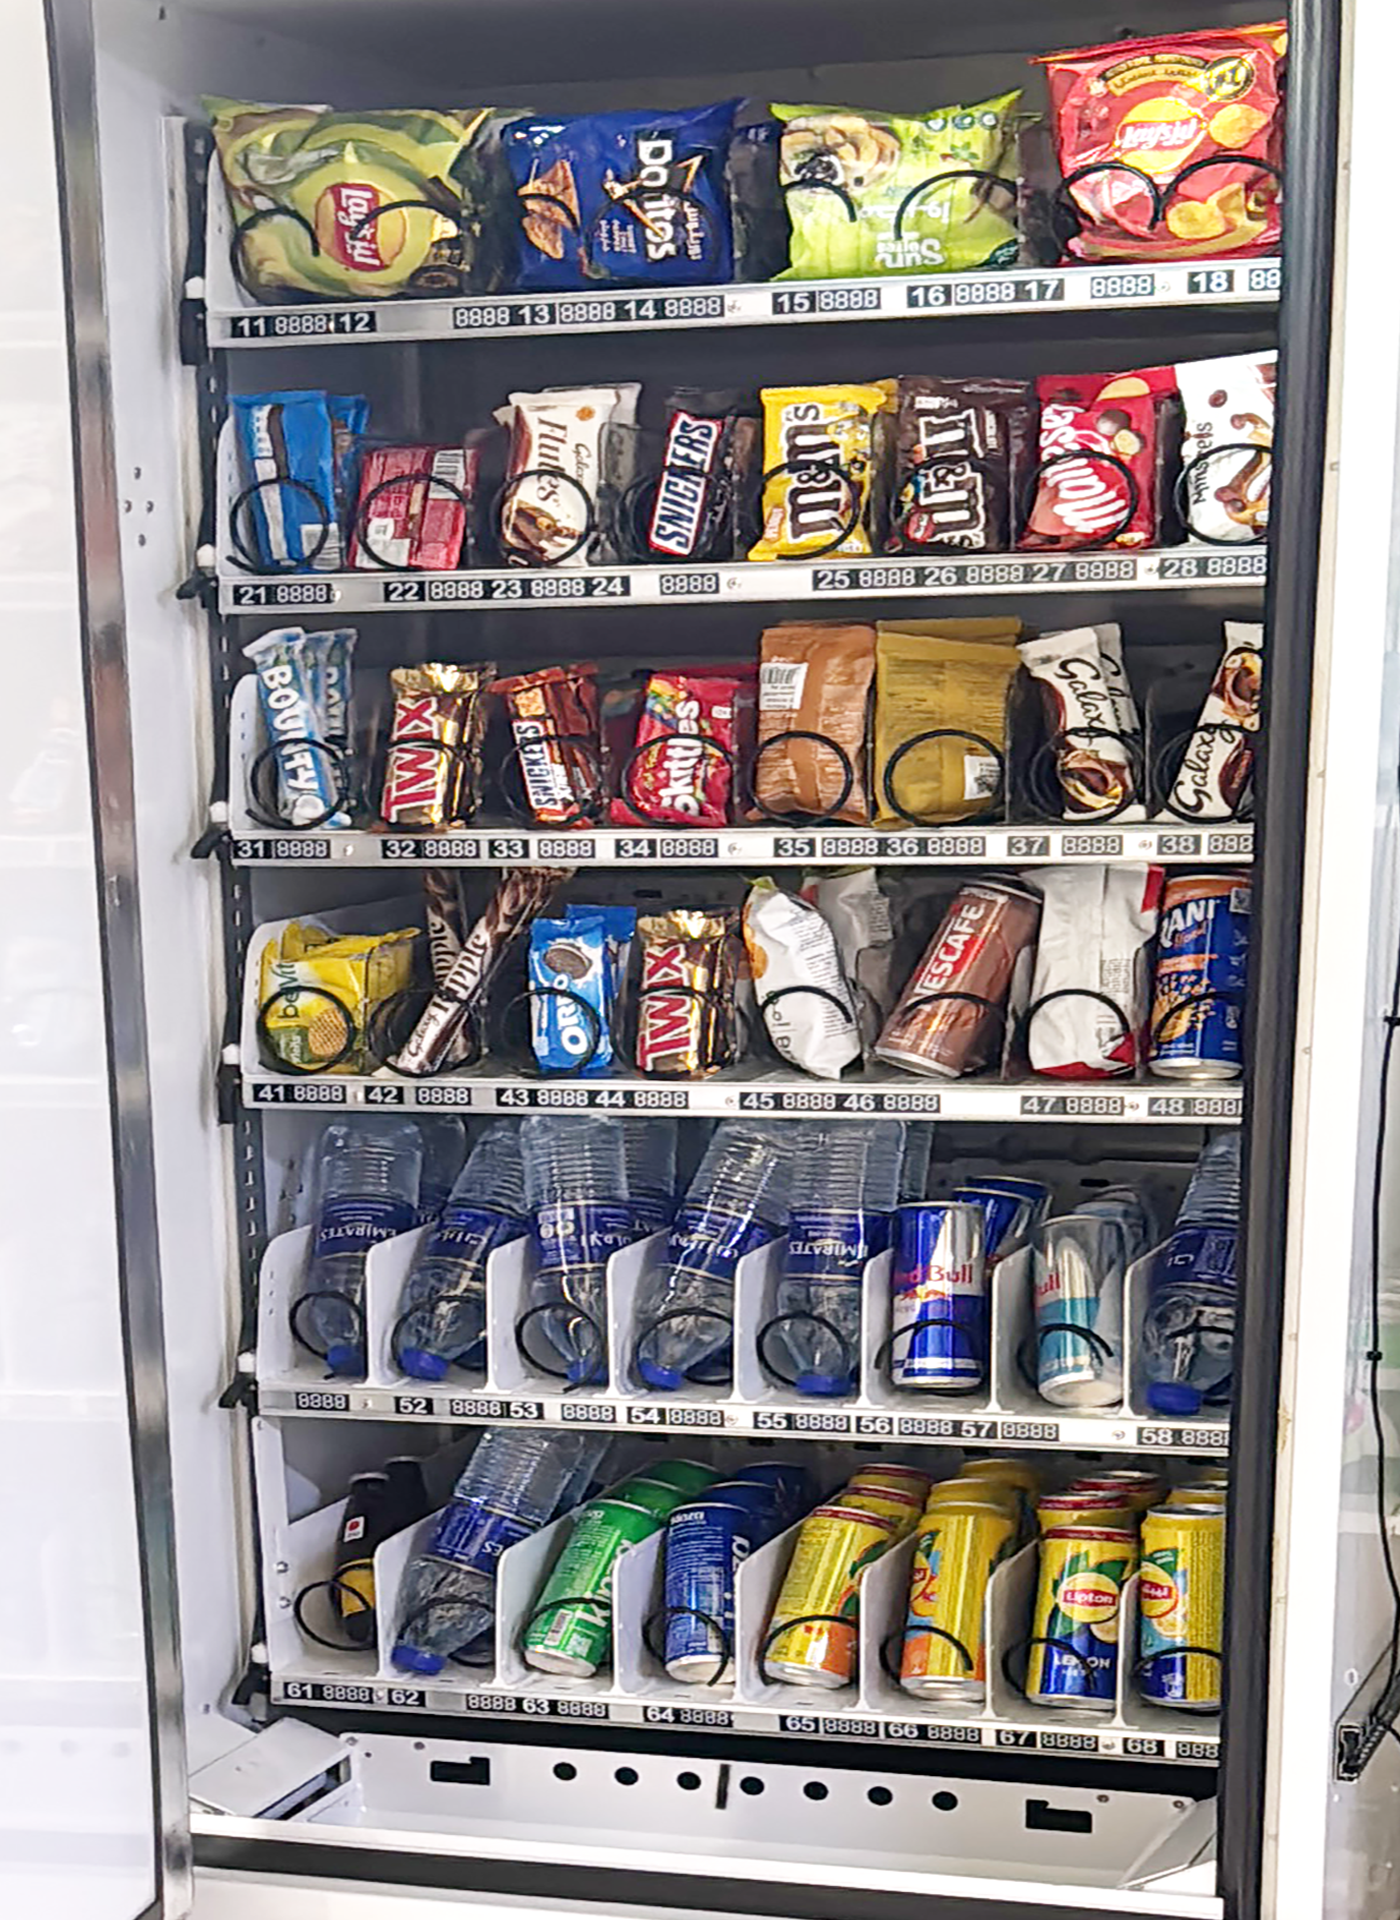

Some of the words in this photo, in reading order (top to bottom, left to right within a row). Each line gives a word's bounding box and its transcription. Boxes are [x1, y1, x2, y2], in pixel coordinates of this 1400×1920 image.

[638, 140, 678, 261] Doitos
[237, 319, 264, 335] 11
[275, 316, 327, 334] 8888
[340, 315, 369, 332] 12
[456, 308, 511, 326] 8888
[520, 306, 549, 324] 13
[561, 303, 615, 320] 8888
[625, 301, 656, 318] 14
[665, 298, 720, 315] 8888
[779, 294, 810, 312] 15
[821, 291, 878, 310] 8888
[913, 288, 944, 305] 16
[956, 285, 1014, 303] 8888
[1025, 282, 1058, 300] 17
[1093, 277, 1152, 295] 8888
[1195, 274, 1228, 291] 18
[572, 443, 592, 486] Galax
[240, 586, 267, 603] 21
[276, 585, 327, 602] 8888
[390, 583, 418, 600] 22
[431, 582, 482, 598] 8888
[493, 580, 522, 597] 23
[531, 579, 584, 596] 8888
[592, 577, 623, 595] 24
[662, 575, 715, 592] 8888
[819, 570, 850, 588] 25
[860, 568, 915, 586] 8888
[924, 567, 958, 585] 26
[967, 564, 1023, 583] 8888
[1033, 563, 1067, 581] 27
[1076, 561, 1133, 579] 8888
[1164, 559, 1197, 578] 28
[381, 697, 440, 822] TWIX
[238, 842, 266, 857] 31
[277, 841, 328, 857] 8888
[387, 842, 415, 857] 32
[425, 841, 477, 857] 8888
[494, 842, 524, 857] 33
[540, 841, 593, 857] 8888
[620, 841, 651, 857] 34
[664, 839, 715, 856] 8888
[779, 838, 811, 855] 35
[822, 838, 877, 855] 8888
[887, 838, 919, 855] 36
[928, 838, 983, 855] 8888
[1012, 837, 1044, 855] 37
[1063, 837, 1121, 855] 8888
[1162, 837, 1195, 854] 38
[636, 943, 695, 1071] TWIX
[259, 1086, 285, 1102] 41
[294, 1085, 342, 1102] 8888
[370, 1087, 397, 1102] 42
[419, 1087, 468, 1104] 8888
[501, 1089, 528, 1106] 43
[538, 1089, 588, 1107] 8888
[596, 1090, 625, 1107] 44
[635, 1090, 685, 1108] 8888
[743, 1093, 774, 1110] 45
[783, 1093, 835, 1110] 8888
[842, 1093, 875, 1110] 46
[884, 1093, 937, 1111] 8888
[1023, 1096, 1056, 1113] 47
[1067, 1096, 1120, 1114] 8888
[1151, 1097, 1184, 1115] 48
[1195, 1098, 1241, 1116] 888
[927, 1264, 974, 1284] Bull
[1034, 1272, 1061, 1298] ull
[298, 1393, 345, 1409] 8888
[401, 1398, 427, 1414] 52
[452, 1400, 500, 1416] 8888
[511, 1401, 537, 1417] 53
[563, 1404, 613, 1420] 8888
[631, 1406, 660, 1423] 54
[671, 1409, 722, 1426] 8888
[758, 1412, 787, 1429] 55
[797, 1414, 848, 1430] 8888
[860, 1416, 890, 1433] 56
[901, 1418, 952, 1435] 8888
[961, 1421, 990, 1437] 57
[1003, 1422, 1056, 1439] 8888
[1142, 1428, 1172, 1445] 58
[1183, 1430, 1228, 1446] 888
[1066, 1591, 1114, 1605] Lipton
[287, 1683, 313, 1698] 61
[323, 1685, 368, 1701] 8888
[392, 1690, 419, 1705] 62
[469, 1695, 516, 1711] 8888
[523, 1698, 549, 1714] 63
[559, 1700, 606, 1717] 8888
[647, 1706, 675, 1722] 64
[681, 1708, 729, 1725] 8888
[787, 1715, 816, 1732] 65
[825, 1719, 875, 1736] 8888
[888, 1722, 918, 1739] 66
[929, 1725, 978, 1742] 8888
[1000, 1729, 1029, 1746] 67
[1043, 1732, 1096, 1750] 8888
[1127, 1738, 1158, 1755] 68
